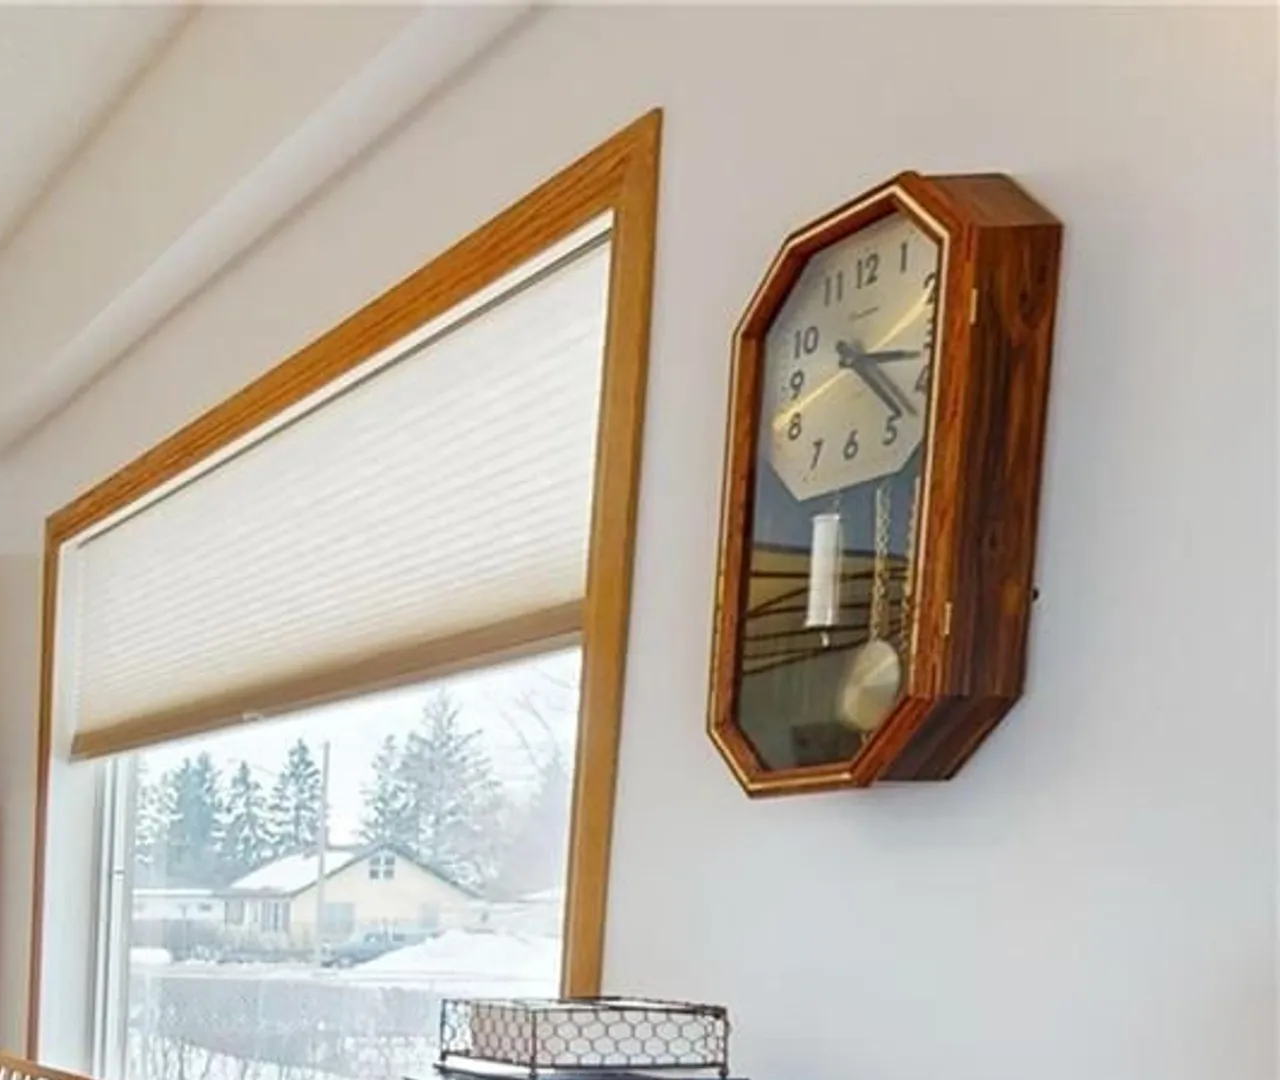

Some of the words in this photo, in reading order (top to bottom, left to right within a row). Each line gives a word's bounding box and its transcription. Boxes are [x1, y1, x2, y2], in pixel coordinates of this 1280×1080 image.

[825, 270, 842, 307] 11
[856, 252, 880, 290] 12
[900, 242, 908, 273] 1
[794, 325, 819, 360] 10
[790, 369, 804, 400] 9
[788, 412, 801, 440] 8
[811, 438, 824, 470] 7
[843, 429, 858, 460] 6
[882, 413, 898, 446] 5
